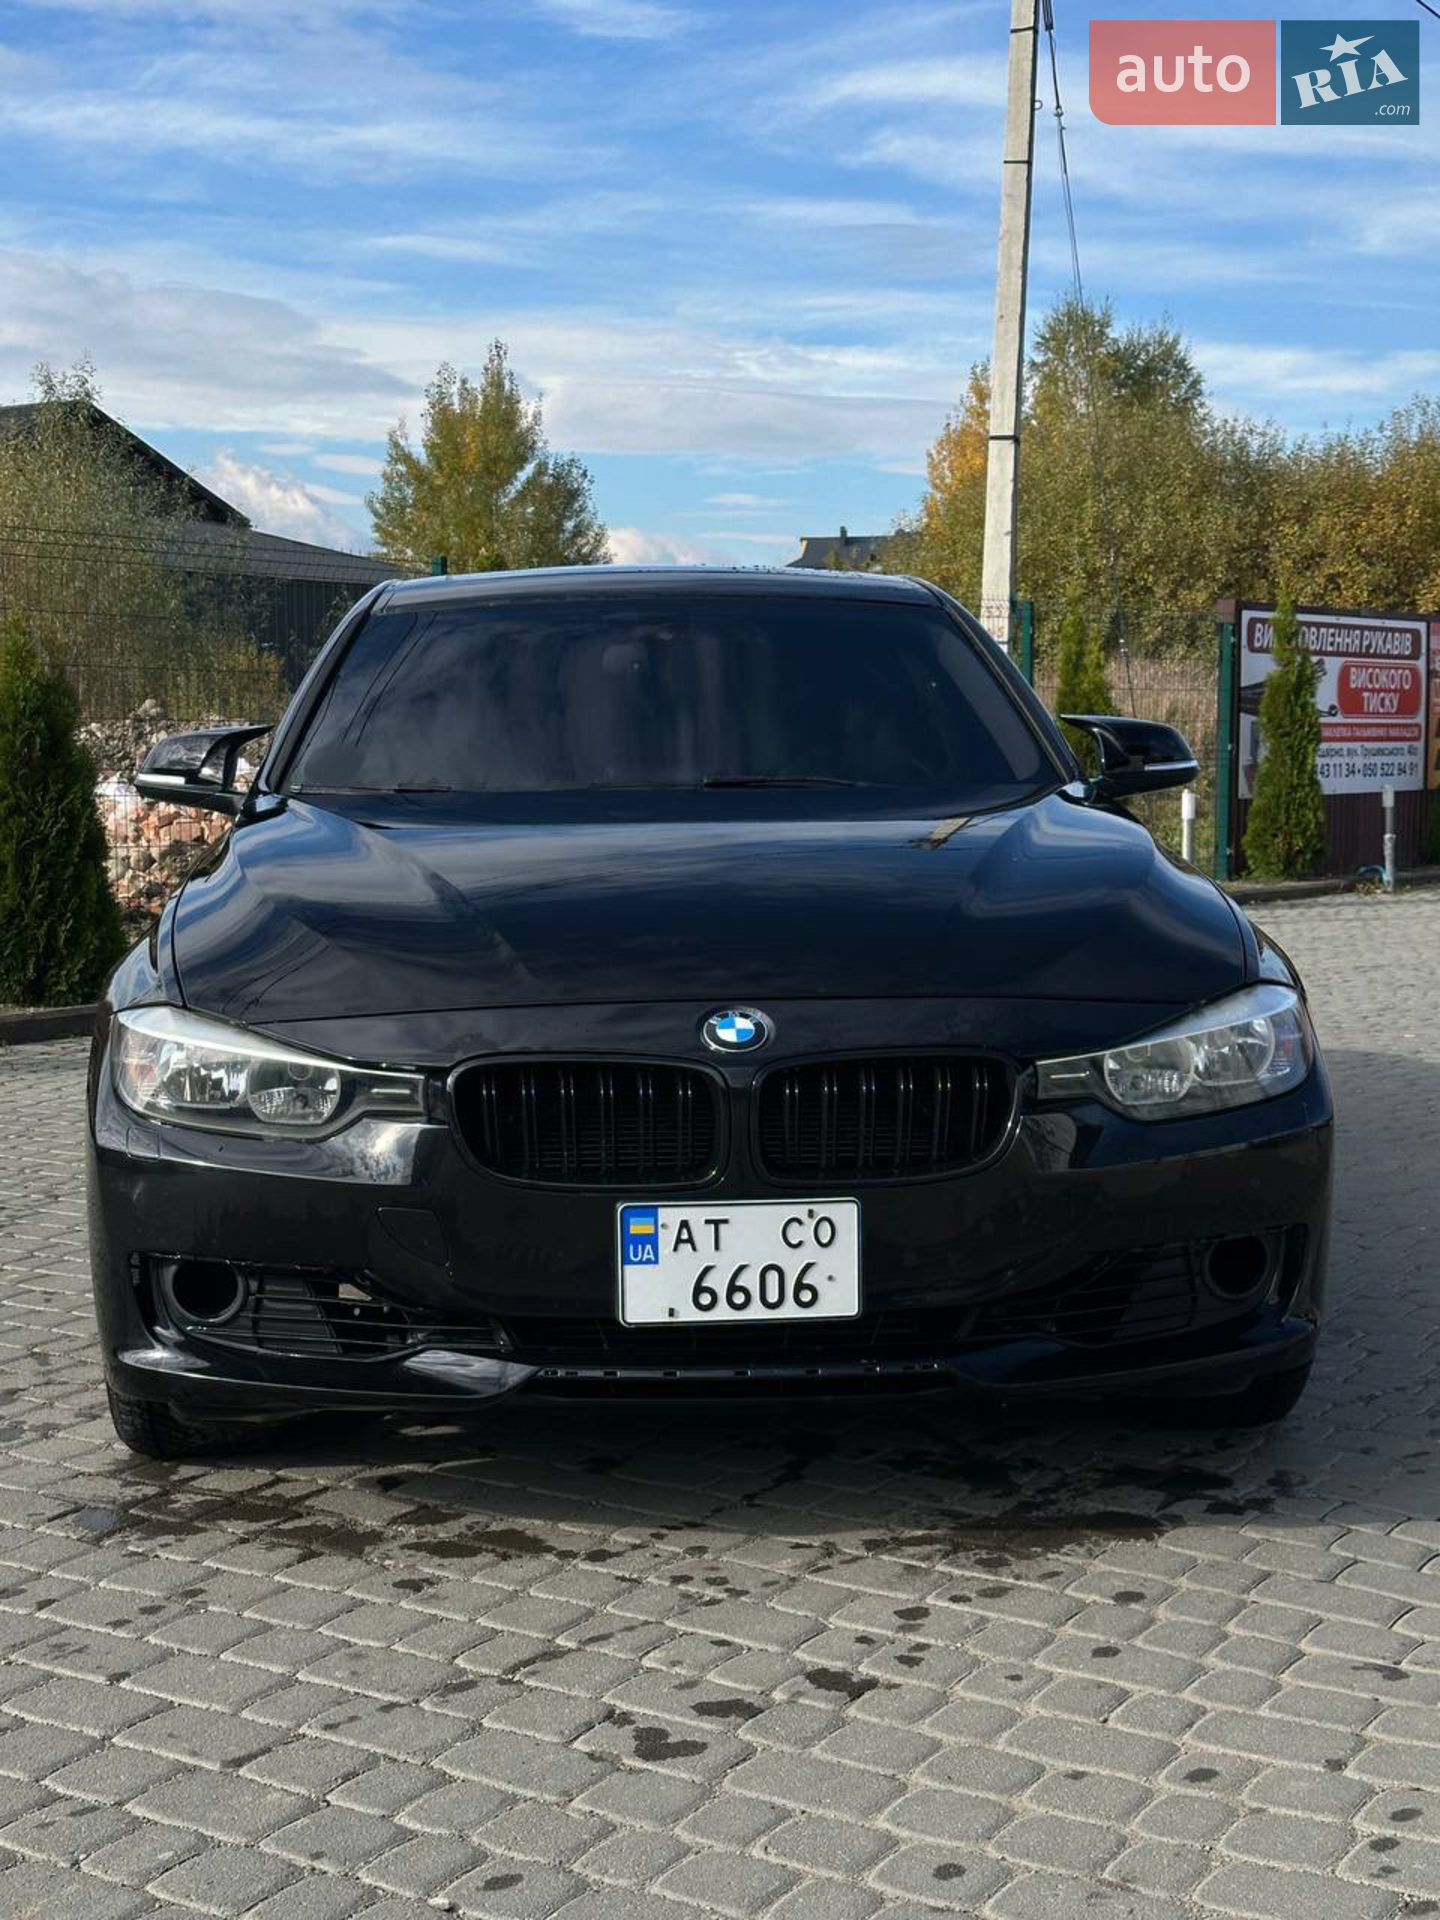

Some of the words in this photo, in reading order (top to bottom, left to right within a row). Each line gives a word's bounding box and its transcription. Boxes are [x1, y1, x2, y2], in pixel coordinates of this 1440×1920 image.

[1254, 623, 1361, 653] ВИОВЛЕННЯ
[1362, 629, 1413, 655] РУКАВІВ
[1349, 667, 1412, 690] ВИСОКОГО
[1362, 692, 1400, 713] ТИСКУ
[1333, 762, 1343, 778] 11
[1345, 762, 1356, 778] 34
[1380, 761, 1395, 777] 522
[672, 1218, 729, 1253] AT
[781, 1216, 836, 1249] CO
[629, 1244, 655, 1262] UA
[692, 1262, 819, 1312] 6606
